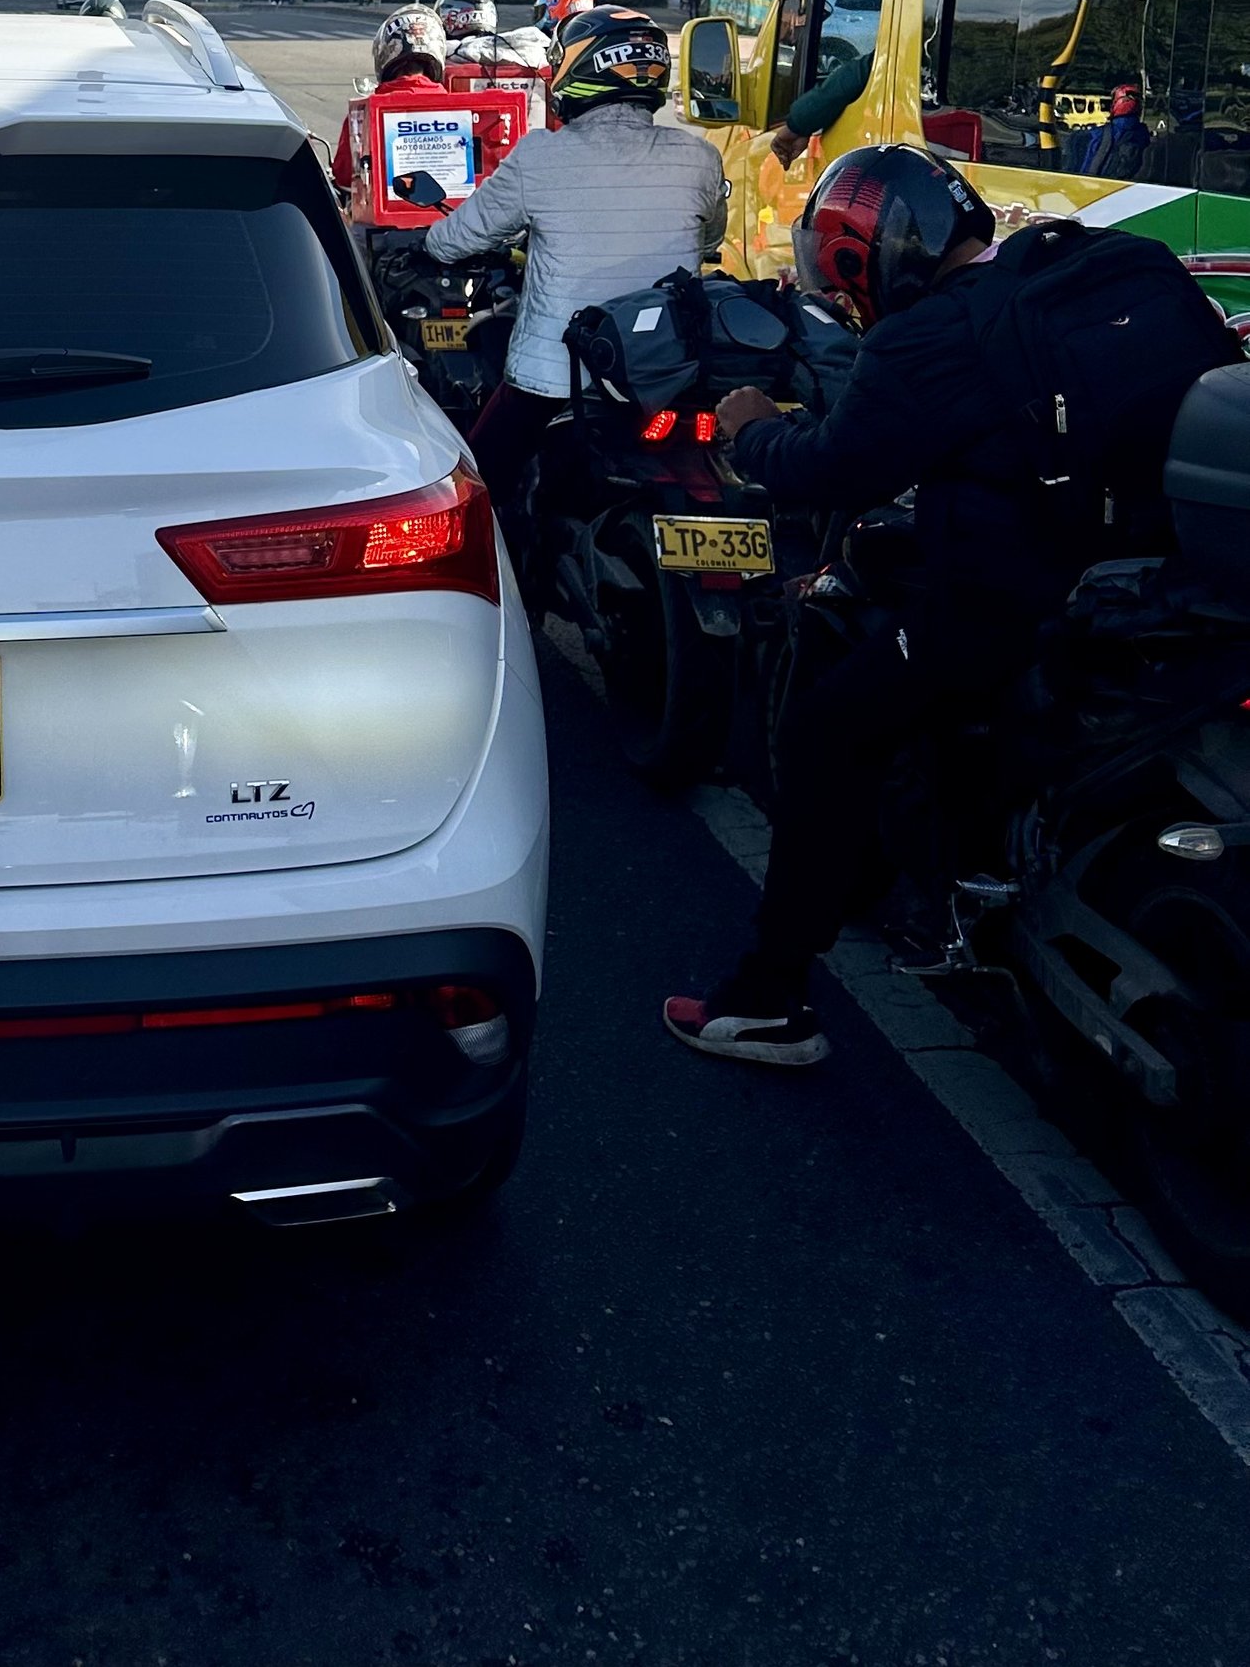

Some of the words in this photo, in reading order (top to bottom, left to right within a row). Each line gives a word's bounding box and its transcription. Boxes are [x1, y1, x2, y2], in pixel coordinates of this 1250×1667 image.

[403, 136, 444, 144] BUSCAMOS
[396, 143, 452, 151] MOTORIZADOS
[230, 779, 291, 804] LTZ
[206, 809, 288, 823] CONTINAUTOS
